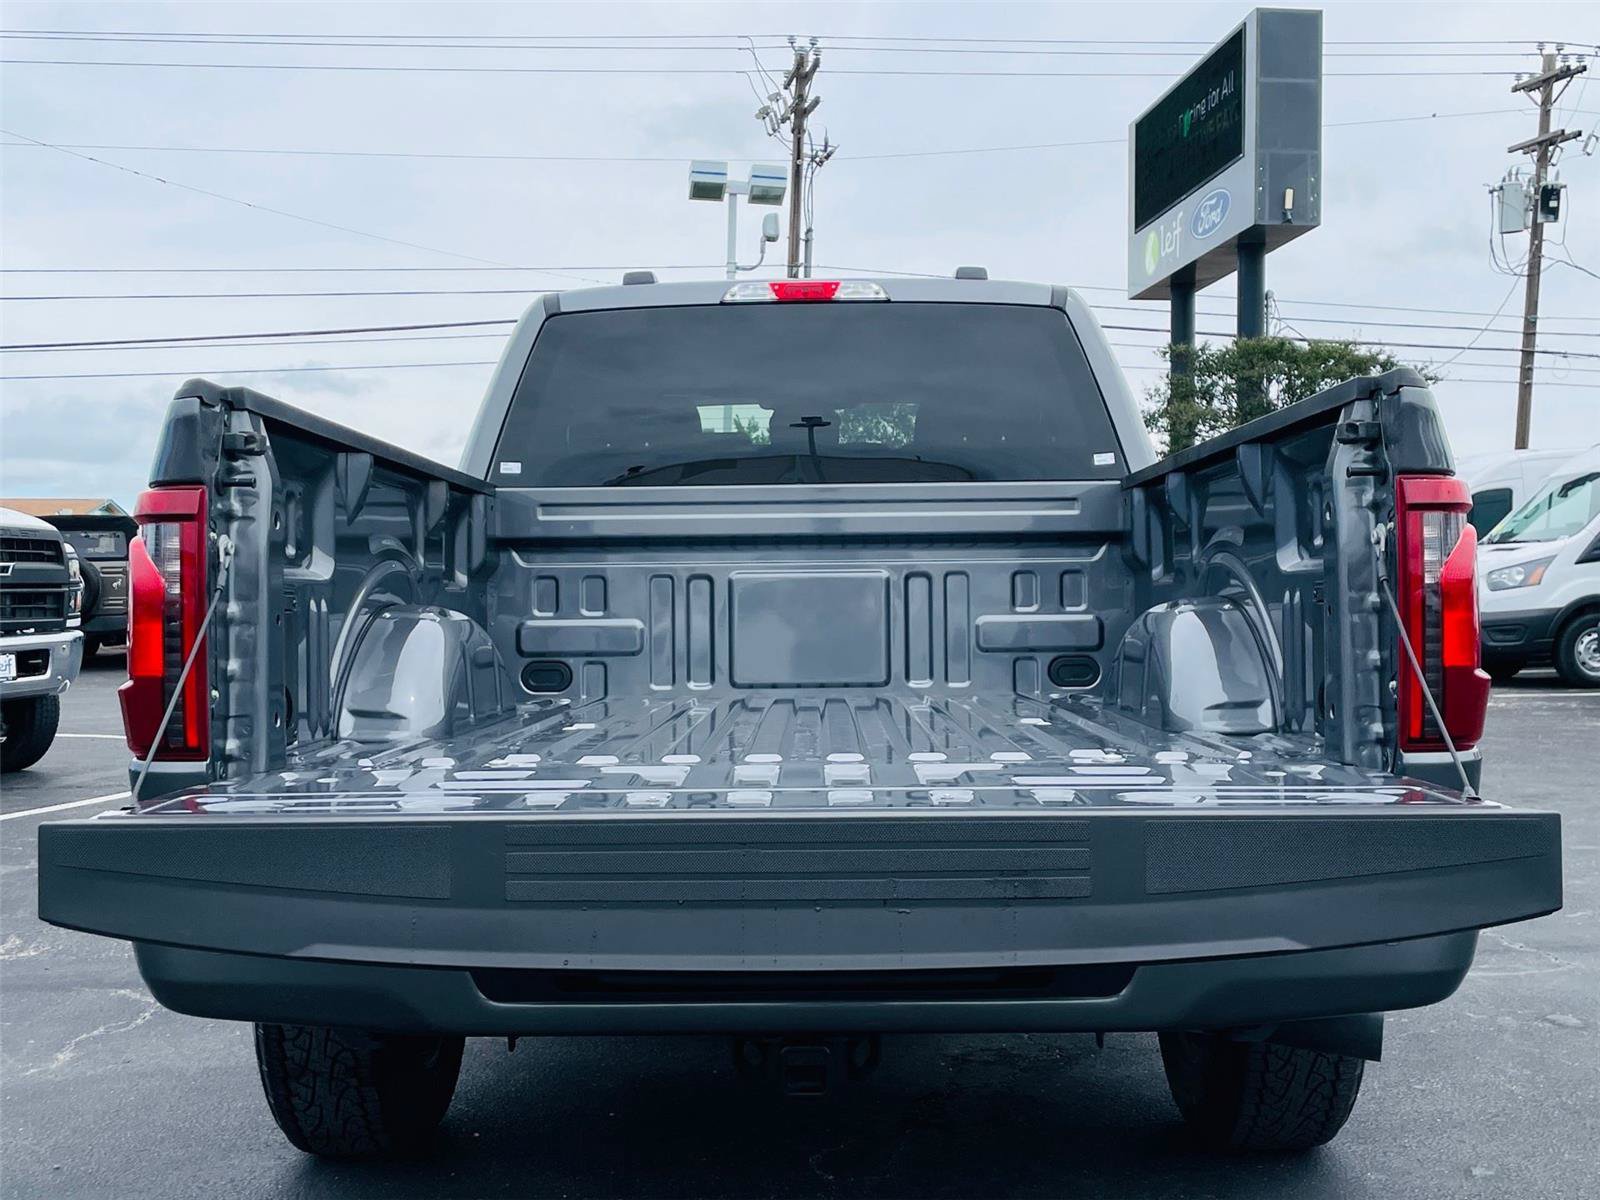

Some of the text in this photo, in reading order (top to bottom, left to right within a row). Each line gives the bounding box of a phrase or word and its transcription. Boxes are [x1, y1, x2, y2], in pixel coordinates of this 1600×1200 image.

[1220, 70, 1235, 99] All
[1160, 196, 1224, 259] leif Ford
